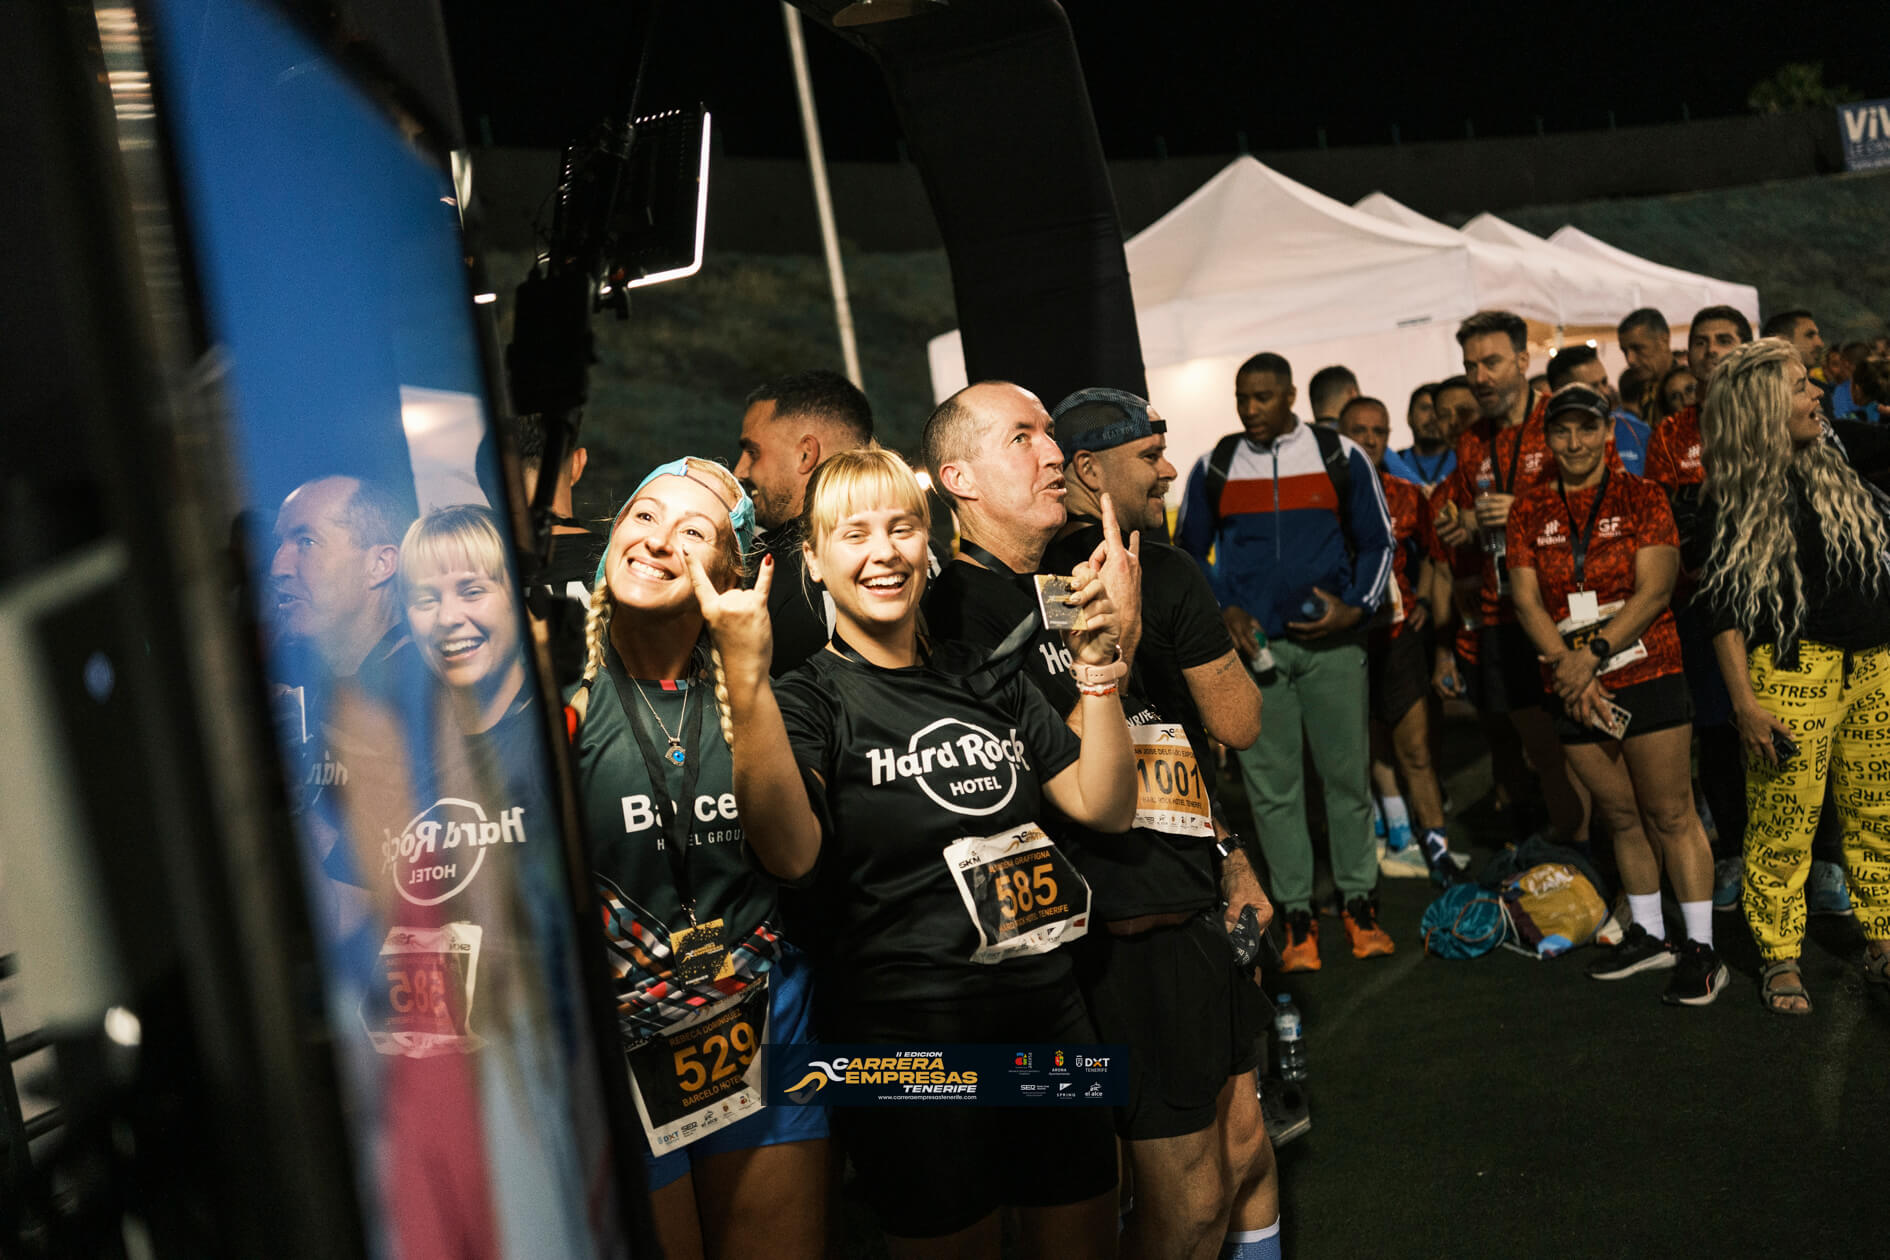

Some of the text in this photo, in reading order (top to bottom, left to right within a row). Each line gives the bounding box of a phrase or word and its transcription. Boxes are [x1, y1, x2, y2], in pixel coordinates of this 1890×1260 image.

[1598, 516, 1621, 532] GF
[1039, 641, 1073, 675] Ha
[1767, 684, 1829, 699] STRESS
[866, 728, 1031, 786] Hard Rock
[1814, 735, 1829, 781] STRESS
[949, 776, 1002, 797] HOTEL
[1137, 758, 1201, 799] 1001
[1772, 792, 1798, 805] ON
[707, 829, 745, 845] GROU
[995, 863, 1058, 919] 585
[1038, 904, 1070, 918] TENERIFE
[674, 1021, 756, 1092] 529
[681, 1085, 720, 1107] BARCELO
